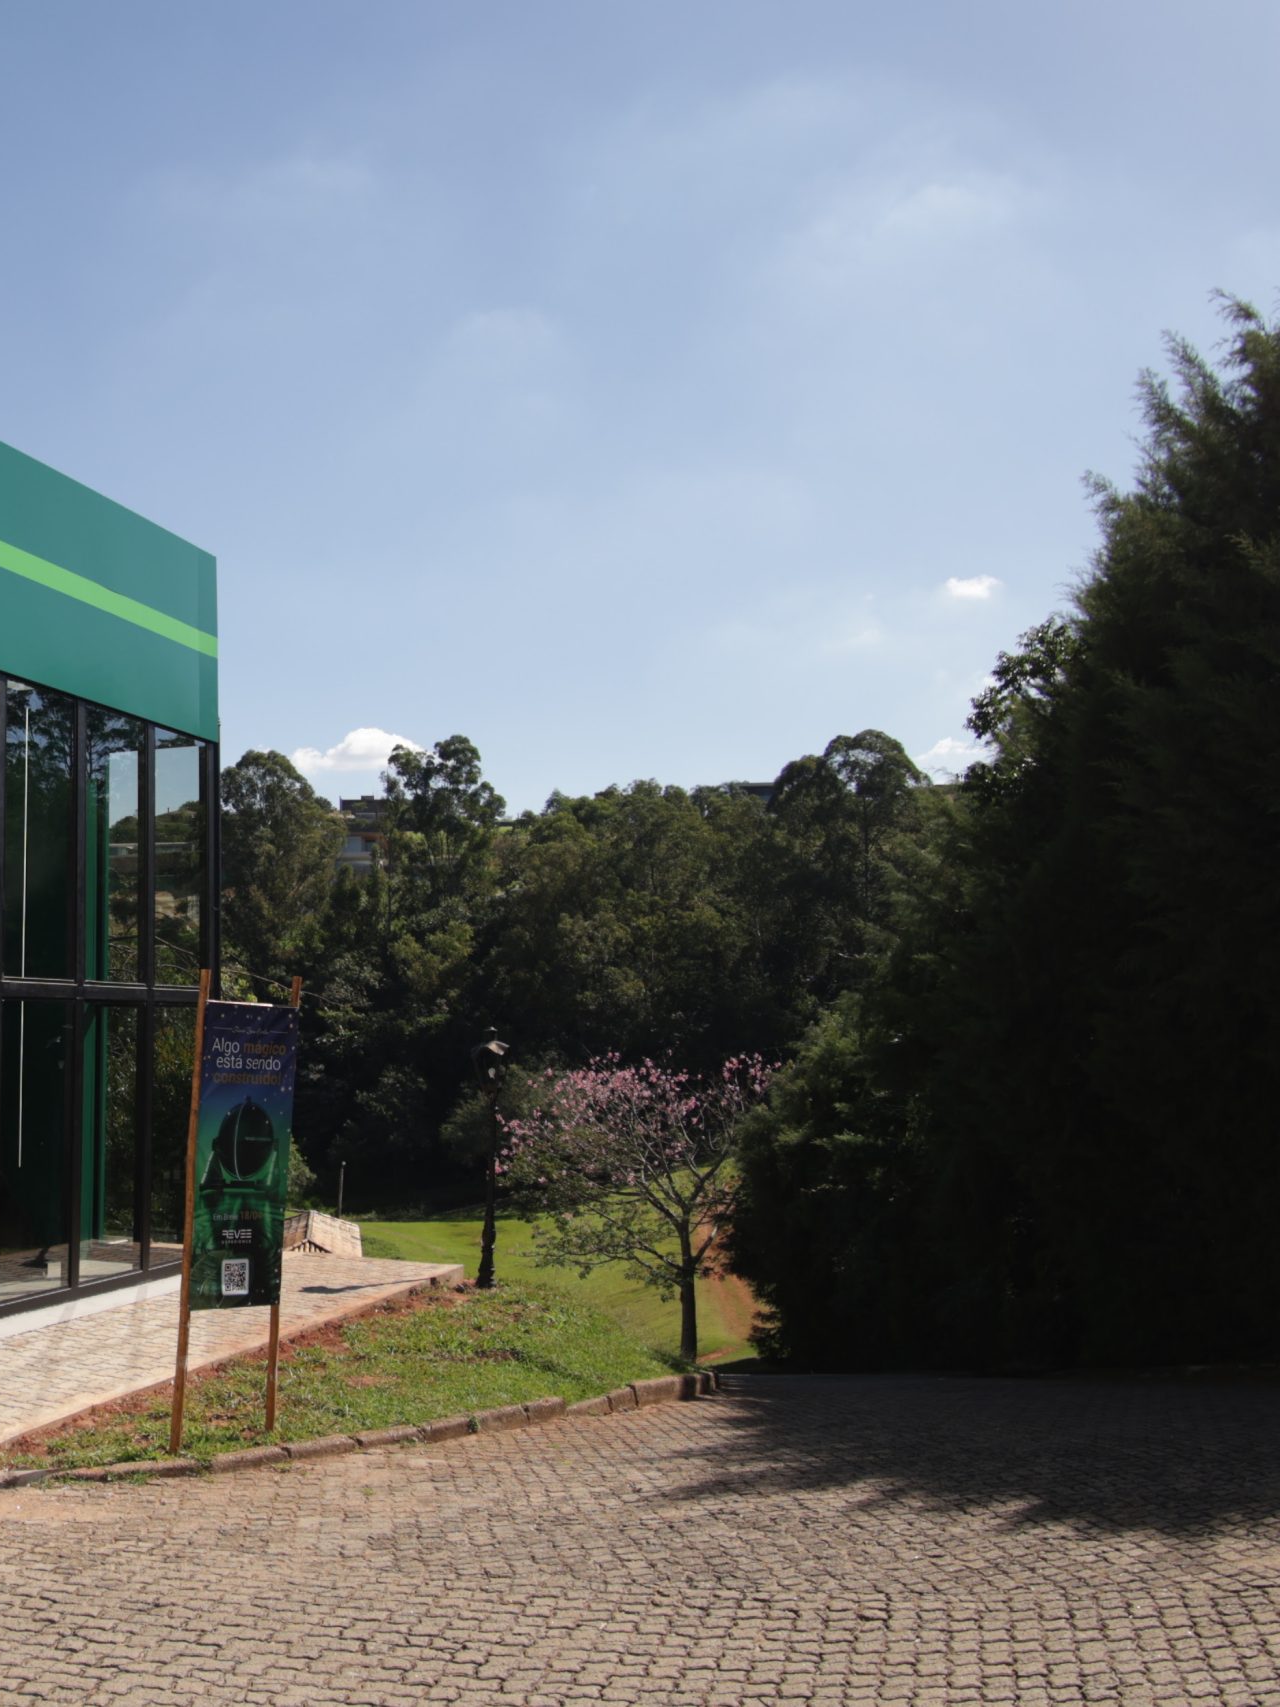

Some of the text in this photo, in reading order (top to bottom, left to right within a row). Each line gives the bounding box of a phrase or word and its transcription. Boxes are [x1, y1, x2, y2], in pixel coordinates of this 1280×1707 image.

[212, 1037, 287, 1056] Algo mágico
[216, 1053, 281, 1071] está sendo
